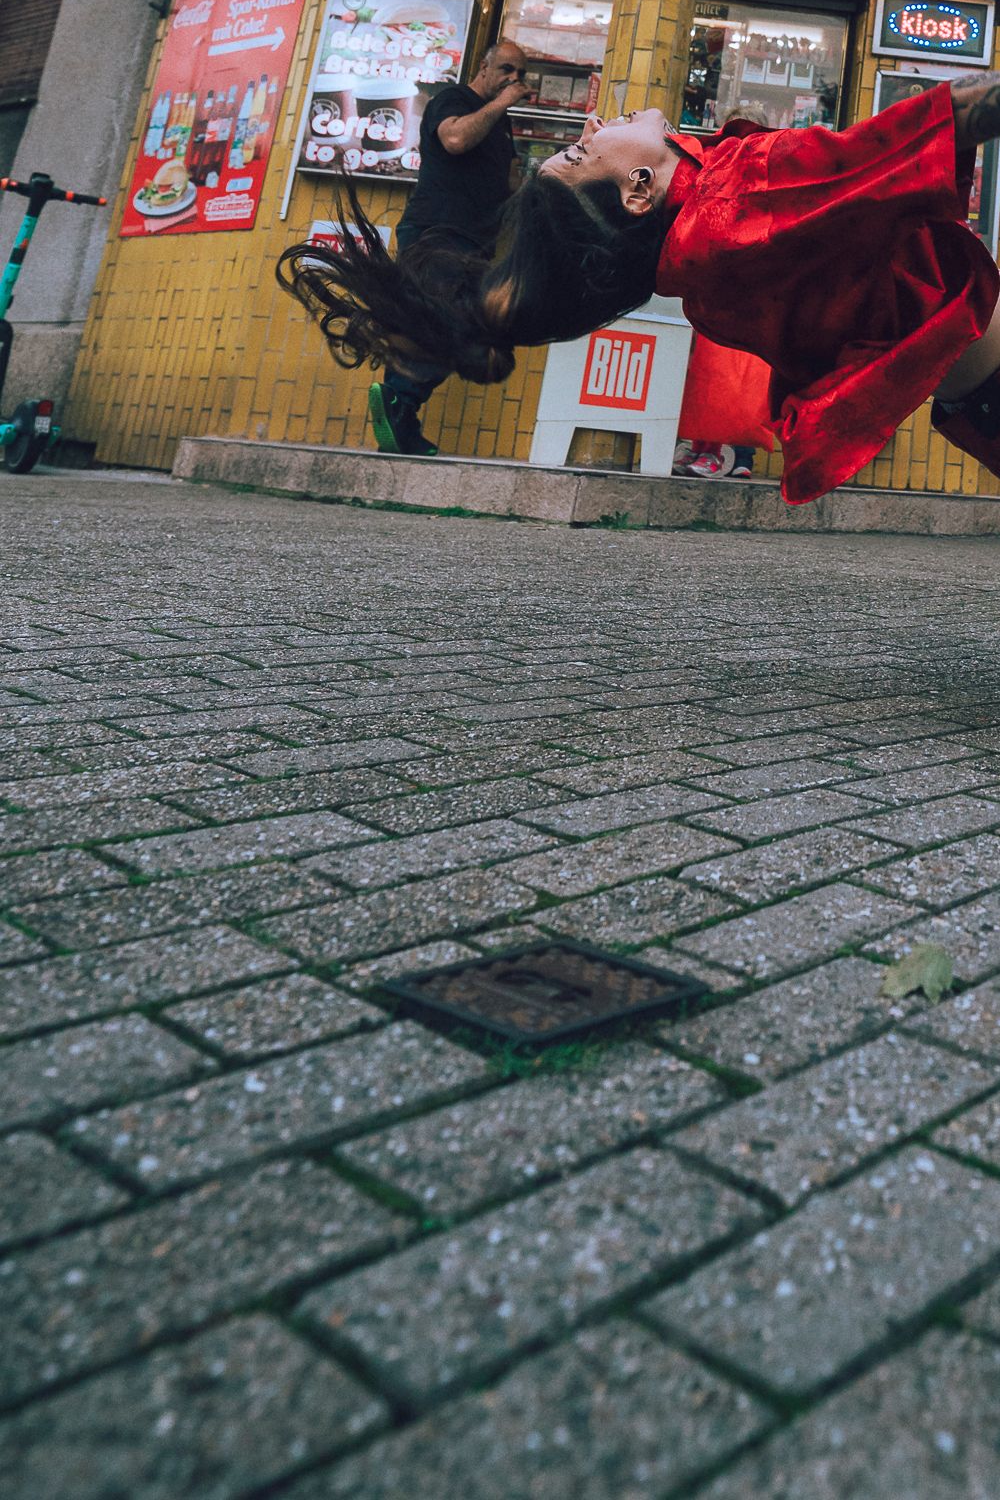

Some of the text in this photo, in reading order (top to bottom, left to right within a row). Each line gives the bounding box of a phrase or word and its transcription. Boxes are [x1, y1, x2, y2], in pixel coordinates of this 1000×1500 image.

[211, 13, 268, 42] mit Coke!
[329, 31, 427, 59] Belegte
[323, 53, 437, 85] Brötchen
[311, 113, 403, 142] Coffee
[305, 141, 379, 171] to go
[586, 336, 651, 401] Bild
